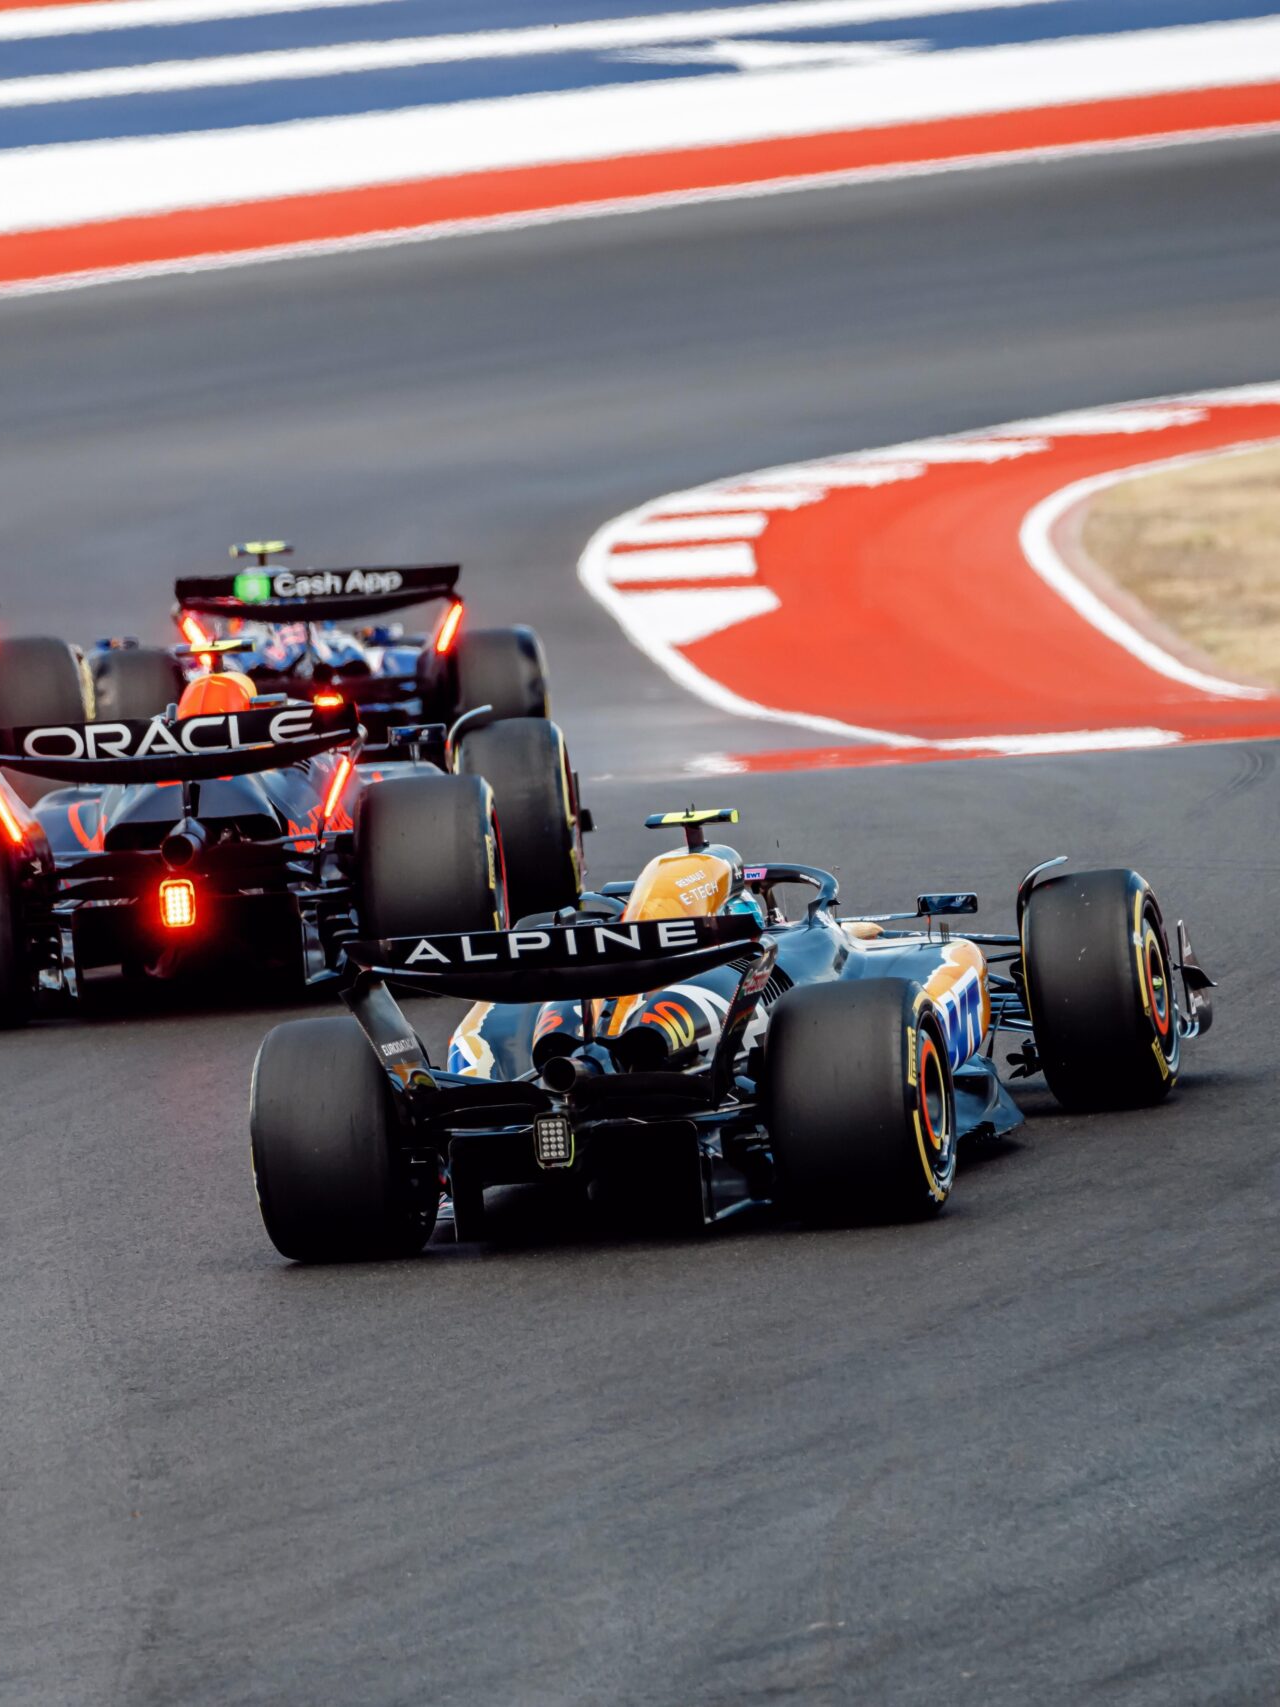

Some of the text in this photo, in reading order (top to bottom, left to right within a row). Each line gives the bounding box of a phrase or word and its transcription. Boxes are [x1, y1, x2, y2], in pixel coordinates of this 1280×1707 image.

[273, 569, 403, 597] Cash App
[23, 708, 314, 759] ORACLE
[679, 879, 719, 906] E-TECH
[404, 920, 699, 965] ALPINE
[641, 1001, 695, 1050] 10
